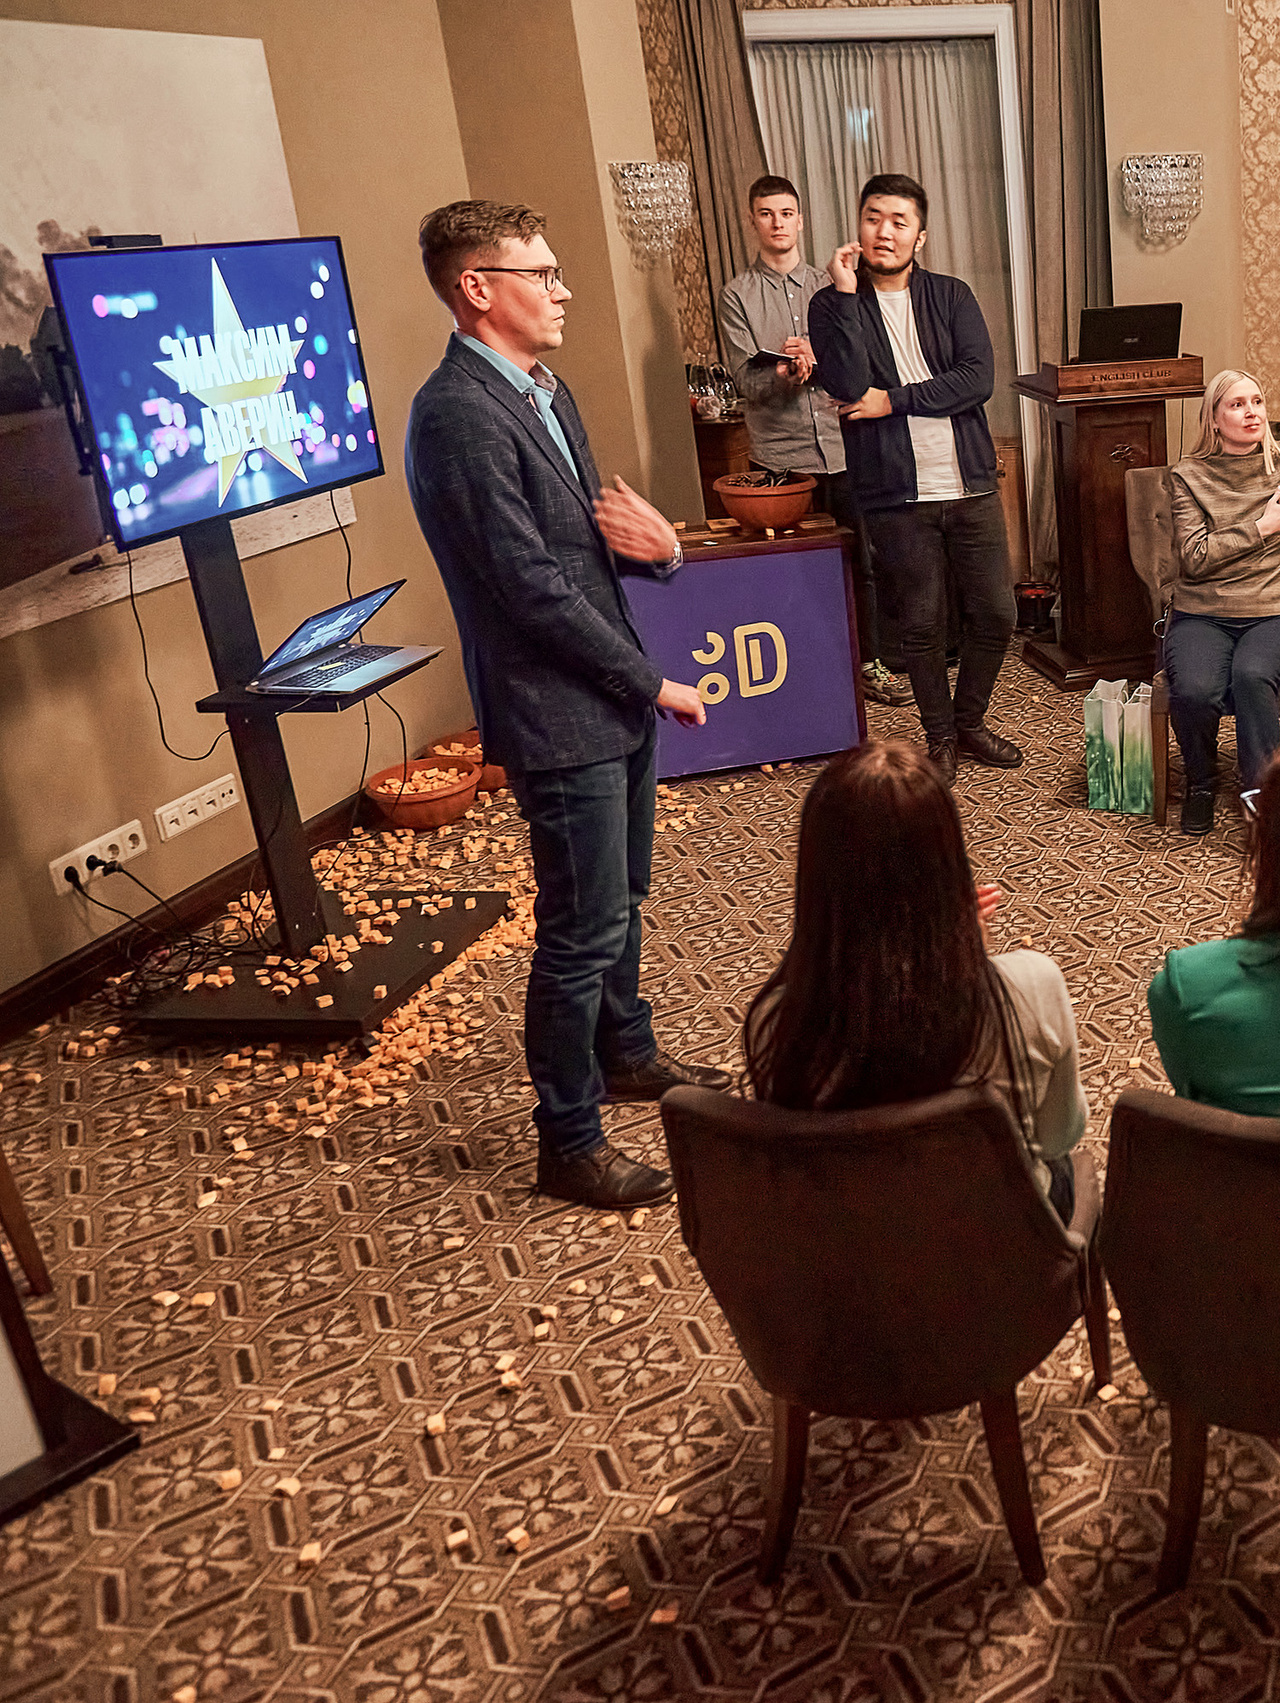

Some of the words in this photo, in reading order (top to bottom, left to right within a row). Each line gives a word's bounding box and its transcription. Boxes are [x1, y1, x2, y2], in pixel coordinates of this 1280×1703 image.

[170, 324, 297, 394] МАКСИМ
[1092, 372, 1140, 381] ENGLISH
[1142, 370, 1171, 378] CLUB
[200, 390, 302, 458] АВЕРИН
